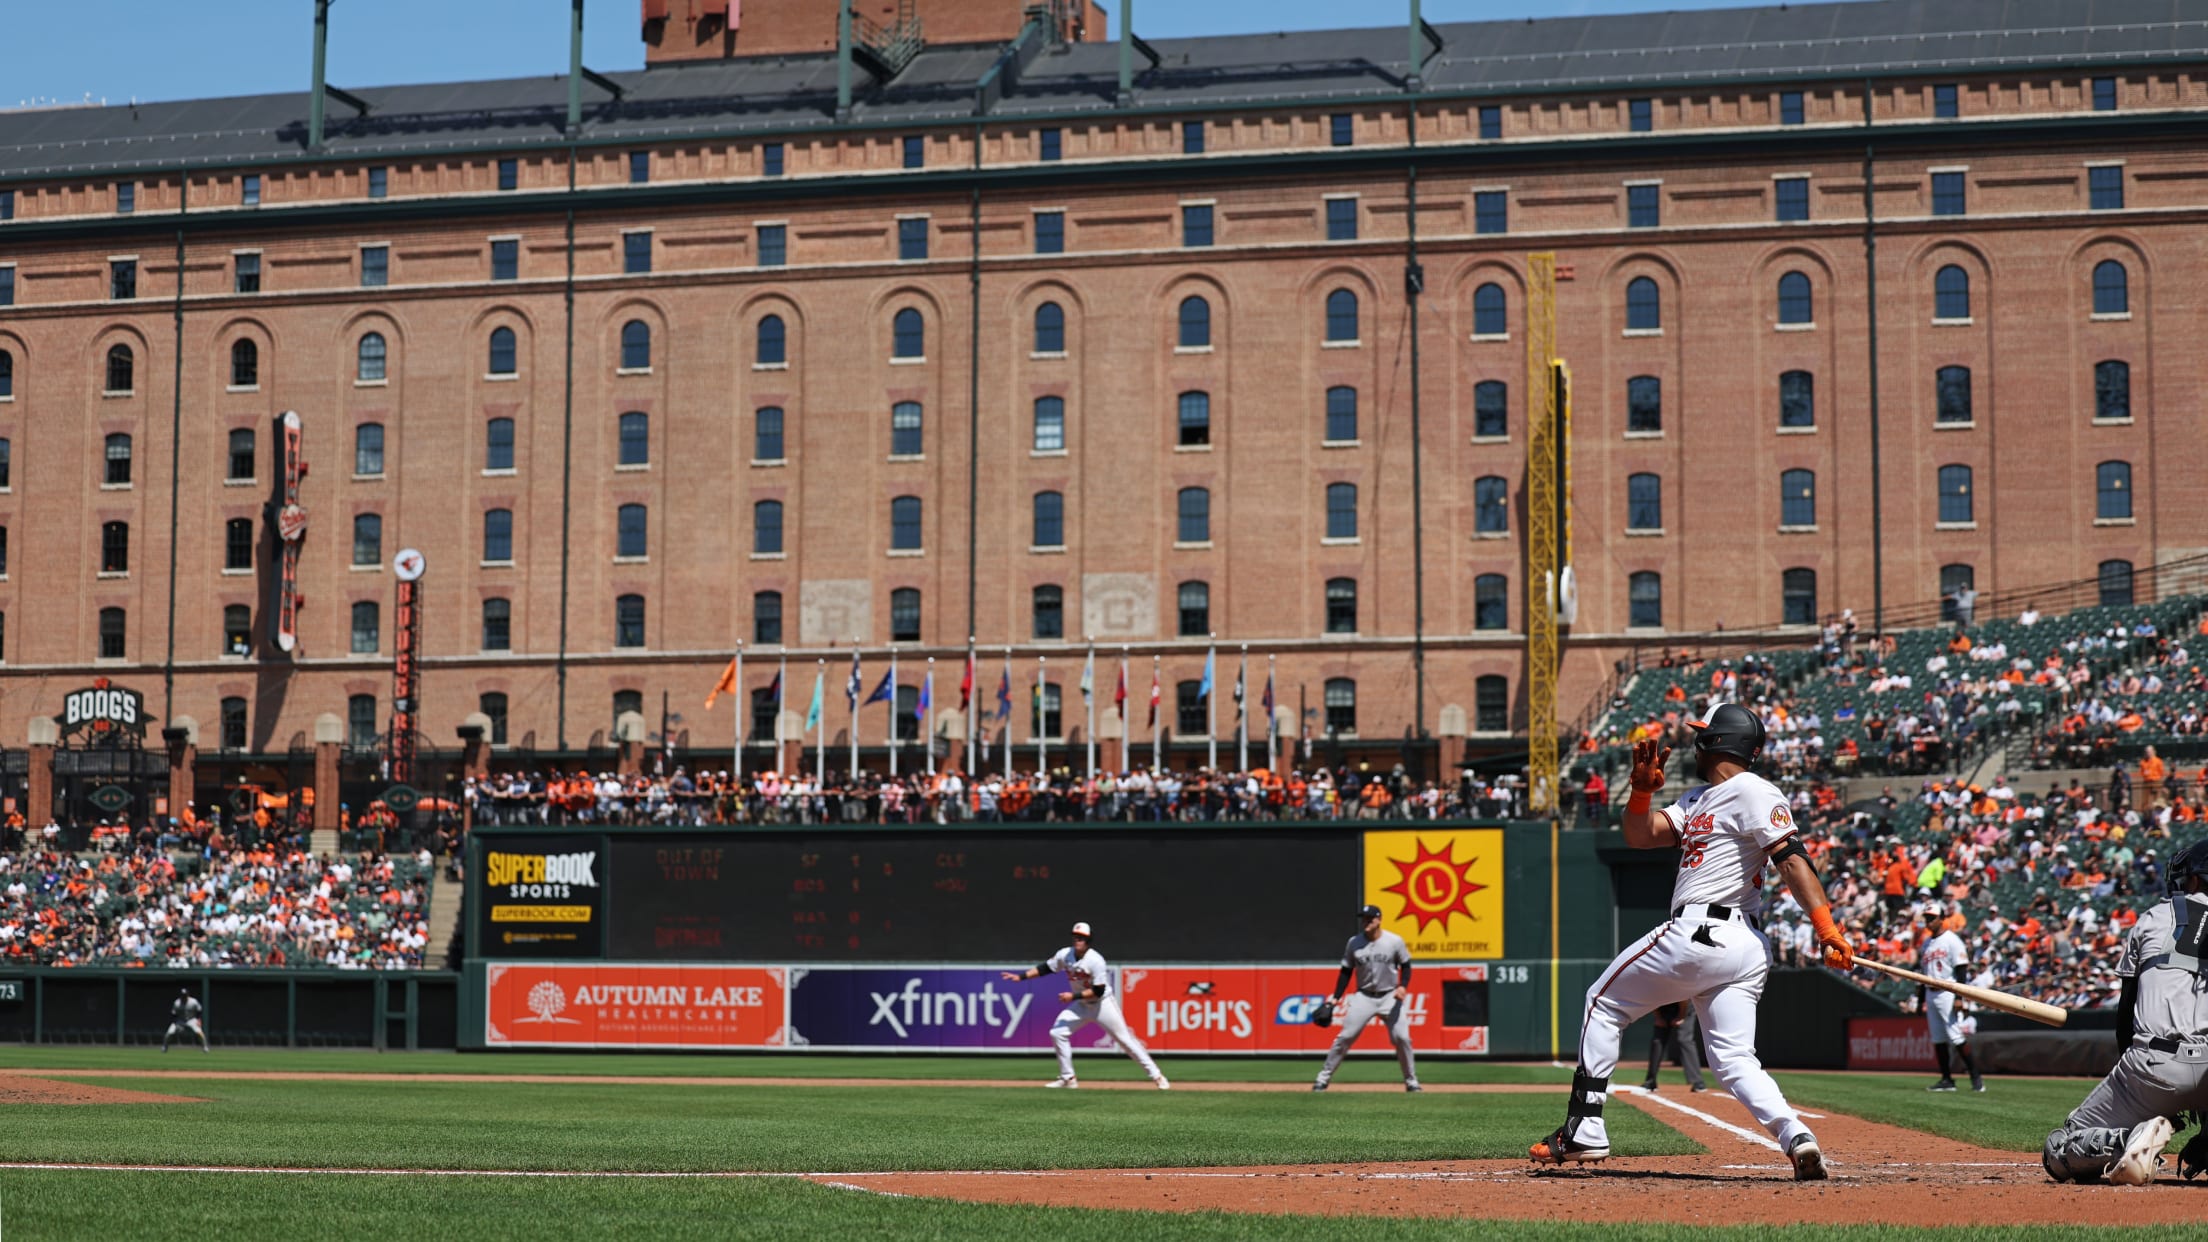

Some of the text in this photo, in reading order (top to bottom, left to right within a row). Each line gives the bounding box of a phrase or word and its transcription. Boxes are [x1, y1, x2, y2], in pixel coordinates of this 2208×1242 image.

[67, 690, 136, 724] BOOG'S
[656, 849, 724, 864] OUT OF
[487, 851, 596, 887] SUPERBOOK
[662, 865, 719, 880] TOWN
[510, 884, 570, 898] SPORTS
[1425, 874, 1444, 898] L
[495, 907, 587, 919] SUPERBOOK.COM
[1495, 966, 1529, 984] 318
[574, 986, 762, 1006] AUTUMN LAKE
[598, 1008, 738, 1021] HEALTHCARE
[869, 979, 1033, 1038] xfinity
[1147, 999, 1252, 1038] HIGH'S
[1851, 1029, 1935, 1060] weis markets
